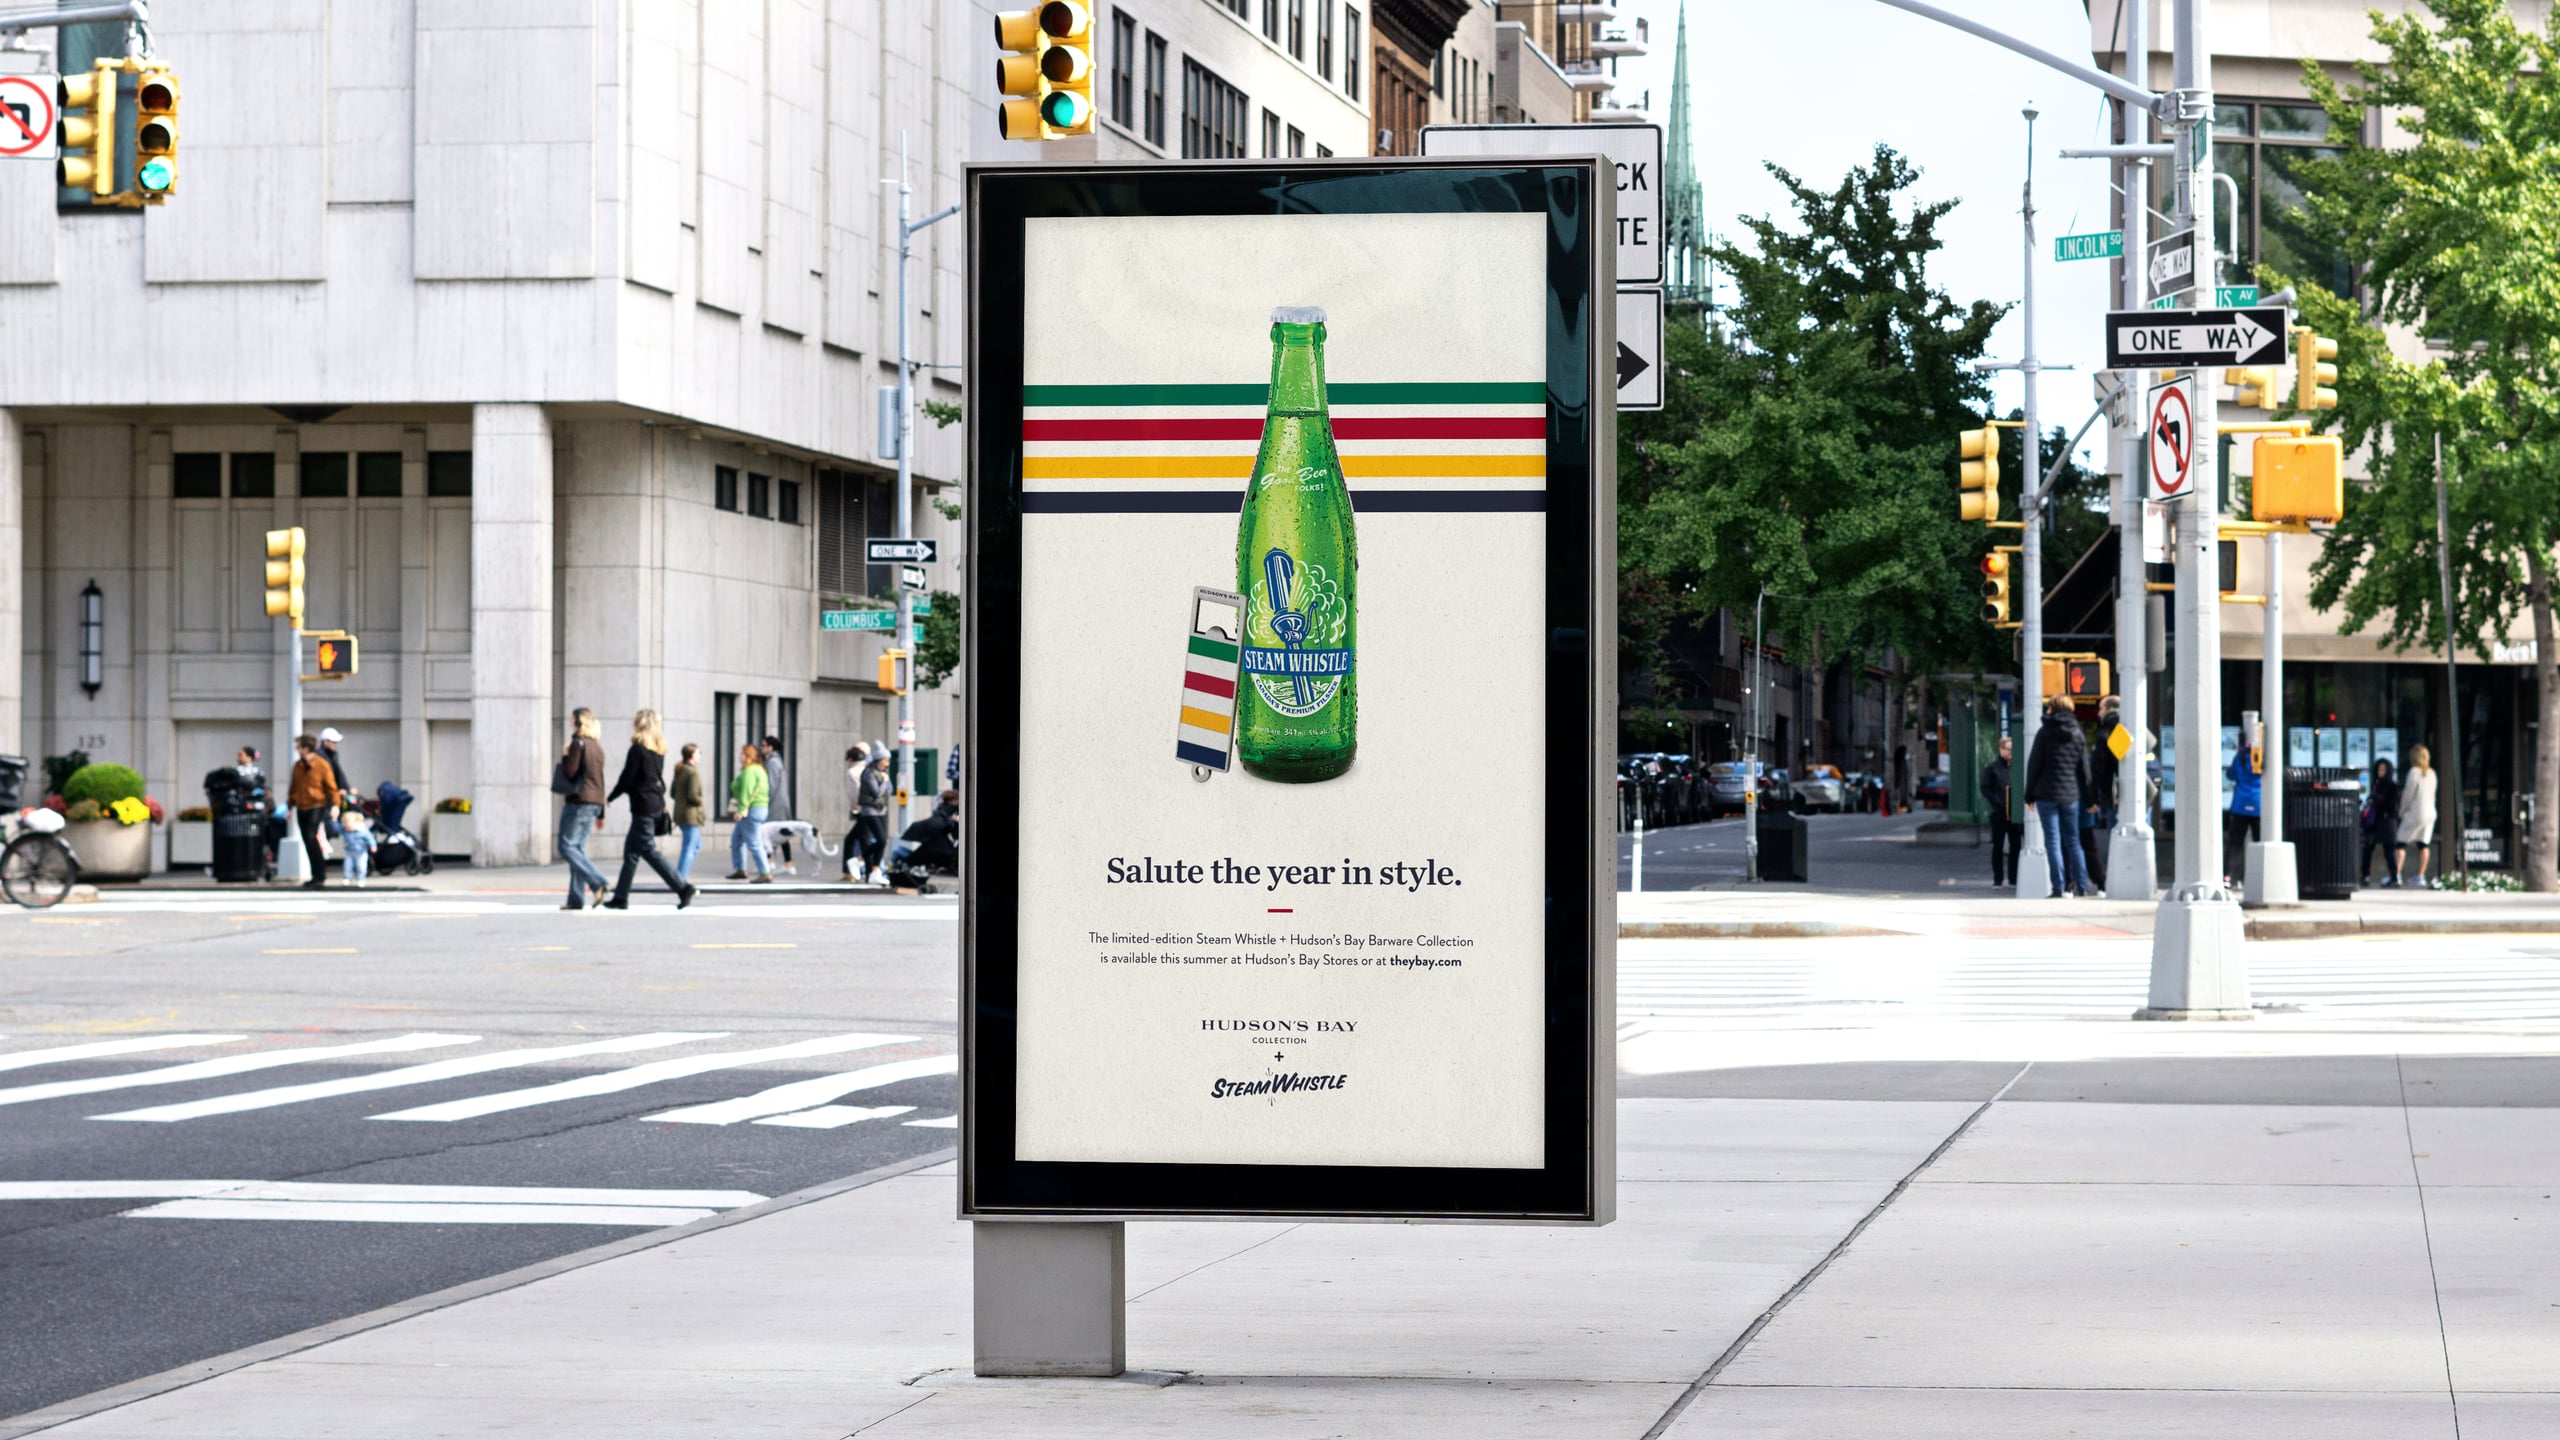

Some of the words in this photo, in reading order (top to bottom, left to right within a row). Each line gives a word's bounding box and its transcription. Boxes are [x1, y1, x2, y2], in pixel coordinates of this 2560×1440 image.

[2056, 235, 2107, 260] LINCOLN
[2110, 234, 2121, 245] SQ
[2153, 258, 2167, 281] ONE
[2173, 250, 2188, 274] WAY
[2240, 290, 2253, 301] AV
[2132, 329, 2182, 351] ONE
[2206, 327, 2258, 349] WAY
[1277, 465, 1291, 473] THE
[1261, 472, 1296, 491] Good
[1296, 466, 1327, 482] Beer
[1295, 483, 1324, 491] FOLKS!
[877, 547, 896, 556] ONE
[906, 547, 926, 556] WAY
[825, 614, 881, 628] COLUMBUS
[1245, 650, 1285, 672] STEAM
[1288, 652, 1348, 673] WHISTLE
[1256, 679, 1280, 709] CANADA'S
[1281, 705, 1317, 715] PREMIUM
[1317, 681, 1338, 708] PILSNER
[2464, 829, 2492, 839] rown
[2464, 840, 2489, 850] arris
[1106, 857, 1205, 885] Salute
[1210, 857, 1261, 885] the
[1267, 865, 1337, 892] year
[1341, 858, 1374, 886] in
[1379, 858, 1463, 893] style.
[1088, 931, 1110, 944] The
[1111, 931, 1194, 945] limited-edition
[1196, 932, 1232, 945] Steam
[1234, 932, 1277, 946] Whistle
[1279, 935, 1287, 943] +
[1290, 933, 1342, 946] Hudson's
[1344, 933, 1366, 951] Bay
[1368, 933, 1414, 947] Barware
[1416, 934, 1474, 948] Collection
[1100, 951, 1109, 964] is
[1111, 951, 1158, 964] available
[1160, 951, 1181, 965] this
[1183, 956, 1229, 966] summer
[1231, 954, 1242, 965] at
[1245, 953, 1296, 966] Hudson's
[1298, 953, 1321, 970] Bay
[1322, 953, 1359, 967] Stores
[1361, 958, 1374, 967] or
[1375, 956, 1388, 967] at
[1389, 954, 1463, 971] theybay.com
[1201, 1019, 1309, 1032] HUDSON'S
[1316, 1020, 1358, 1033] BAY
[1251, 1036, 1308, 1045] COLLECTION
